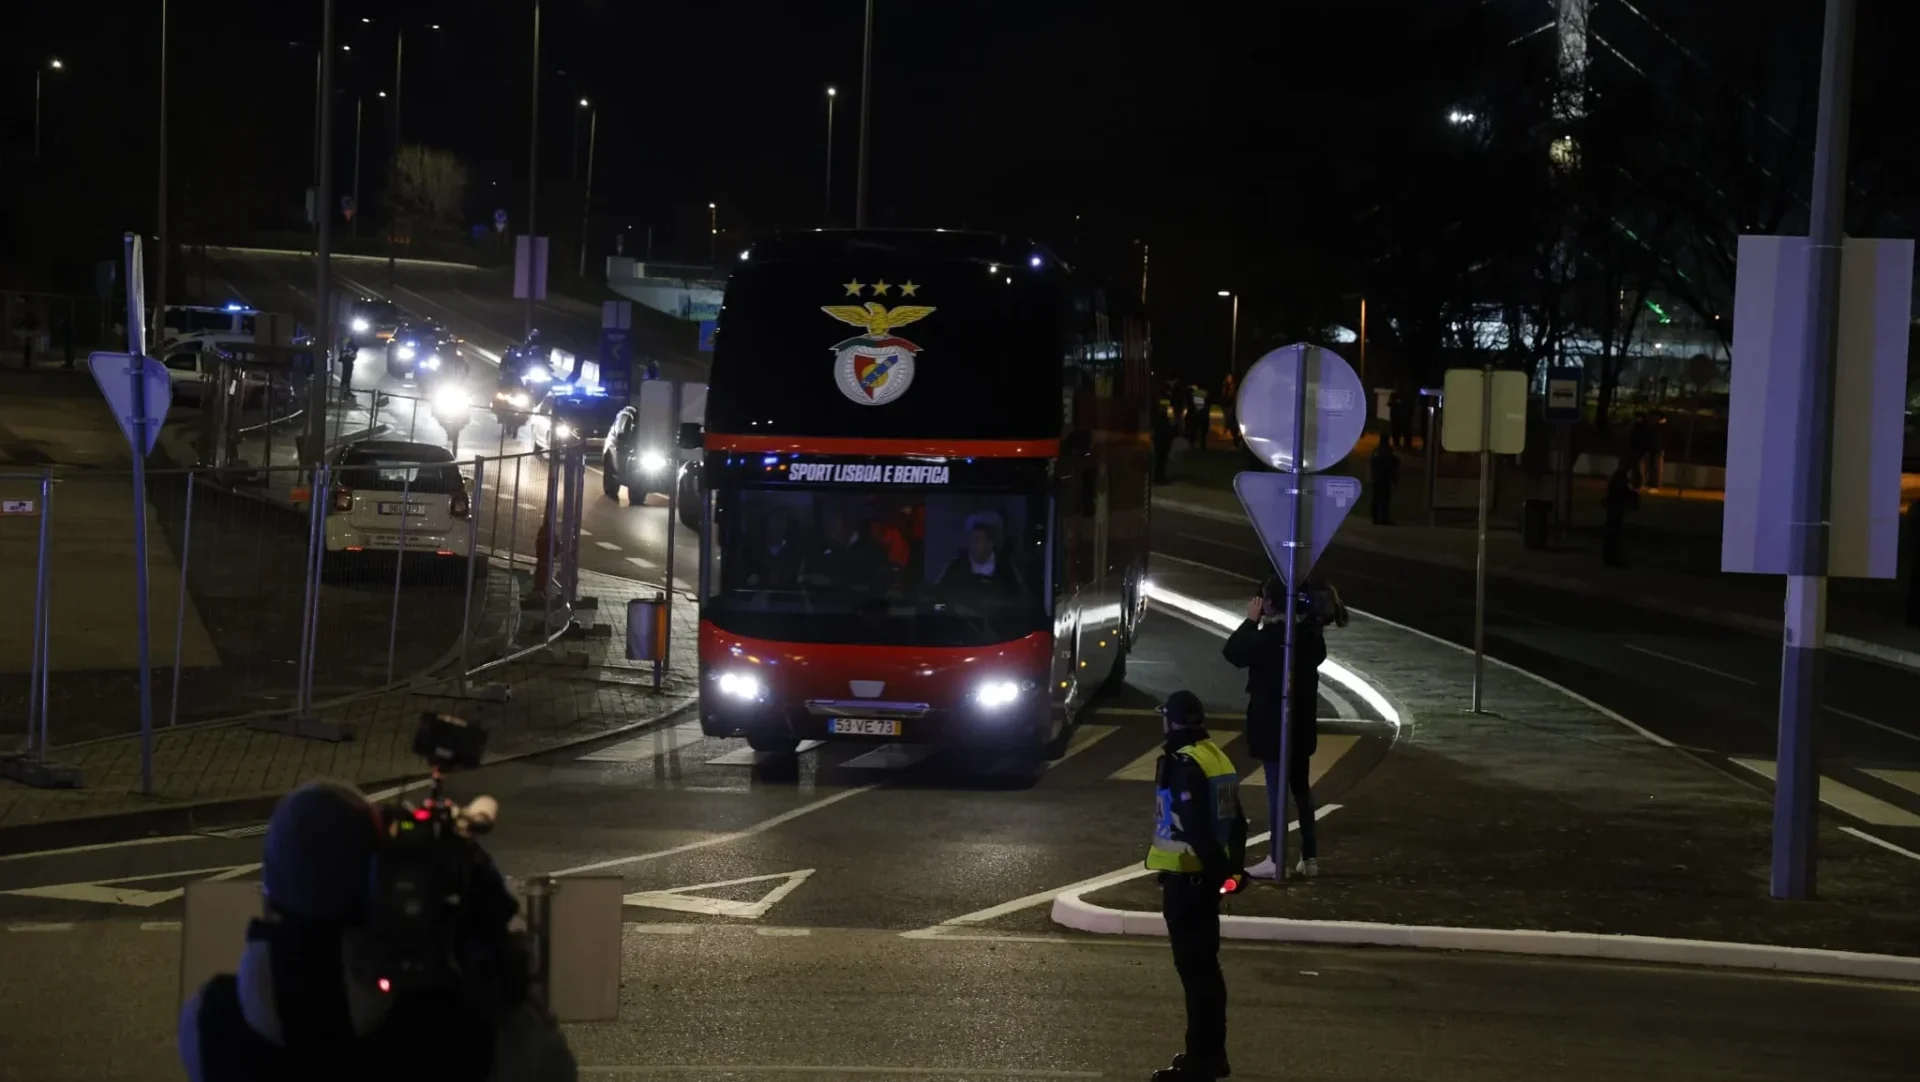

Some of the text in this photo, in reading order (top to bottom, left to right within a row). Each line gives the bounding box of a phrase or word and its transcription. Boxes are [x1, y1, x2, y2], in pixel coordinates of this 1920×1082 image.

[788, 463, 949, 484] SPORT LISBOA E BENFICA
